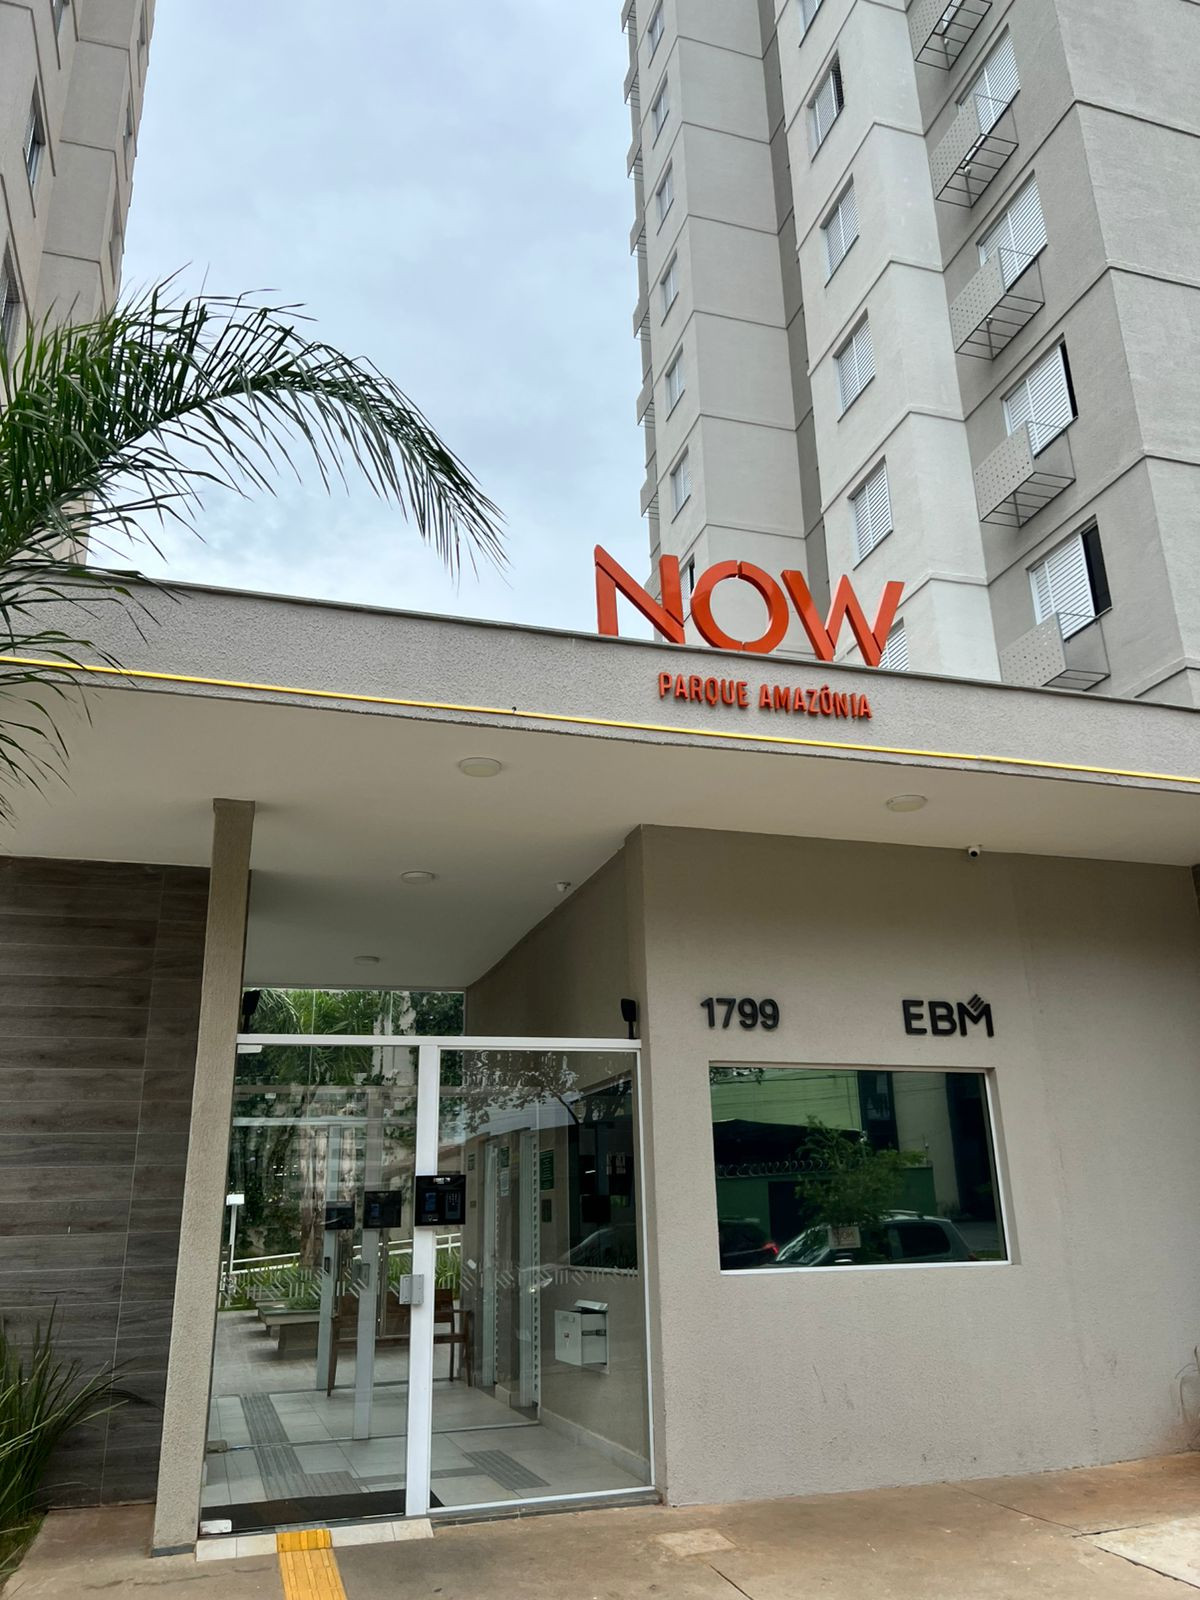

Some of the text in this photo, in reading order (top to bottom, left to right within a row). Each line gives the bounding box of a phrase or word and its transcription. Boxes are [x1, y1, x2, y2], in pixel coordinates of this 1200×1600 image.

[593, 544, 905, 667] NOW
[658, 672, 873, 720] PARQUE AMAZÔNIA
[700, 997, 780, 1030] 1799
[902, 994, 994, 1037] EBM
